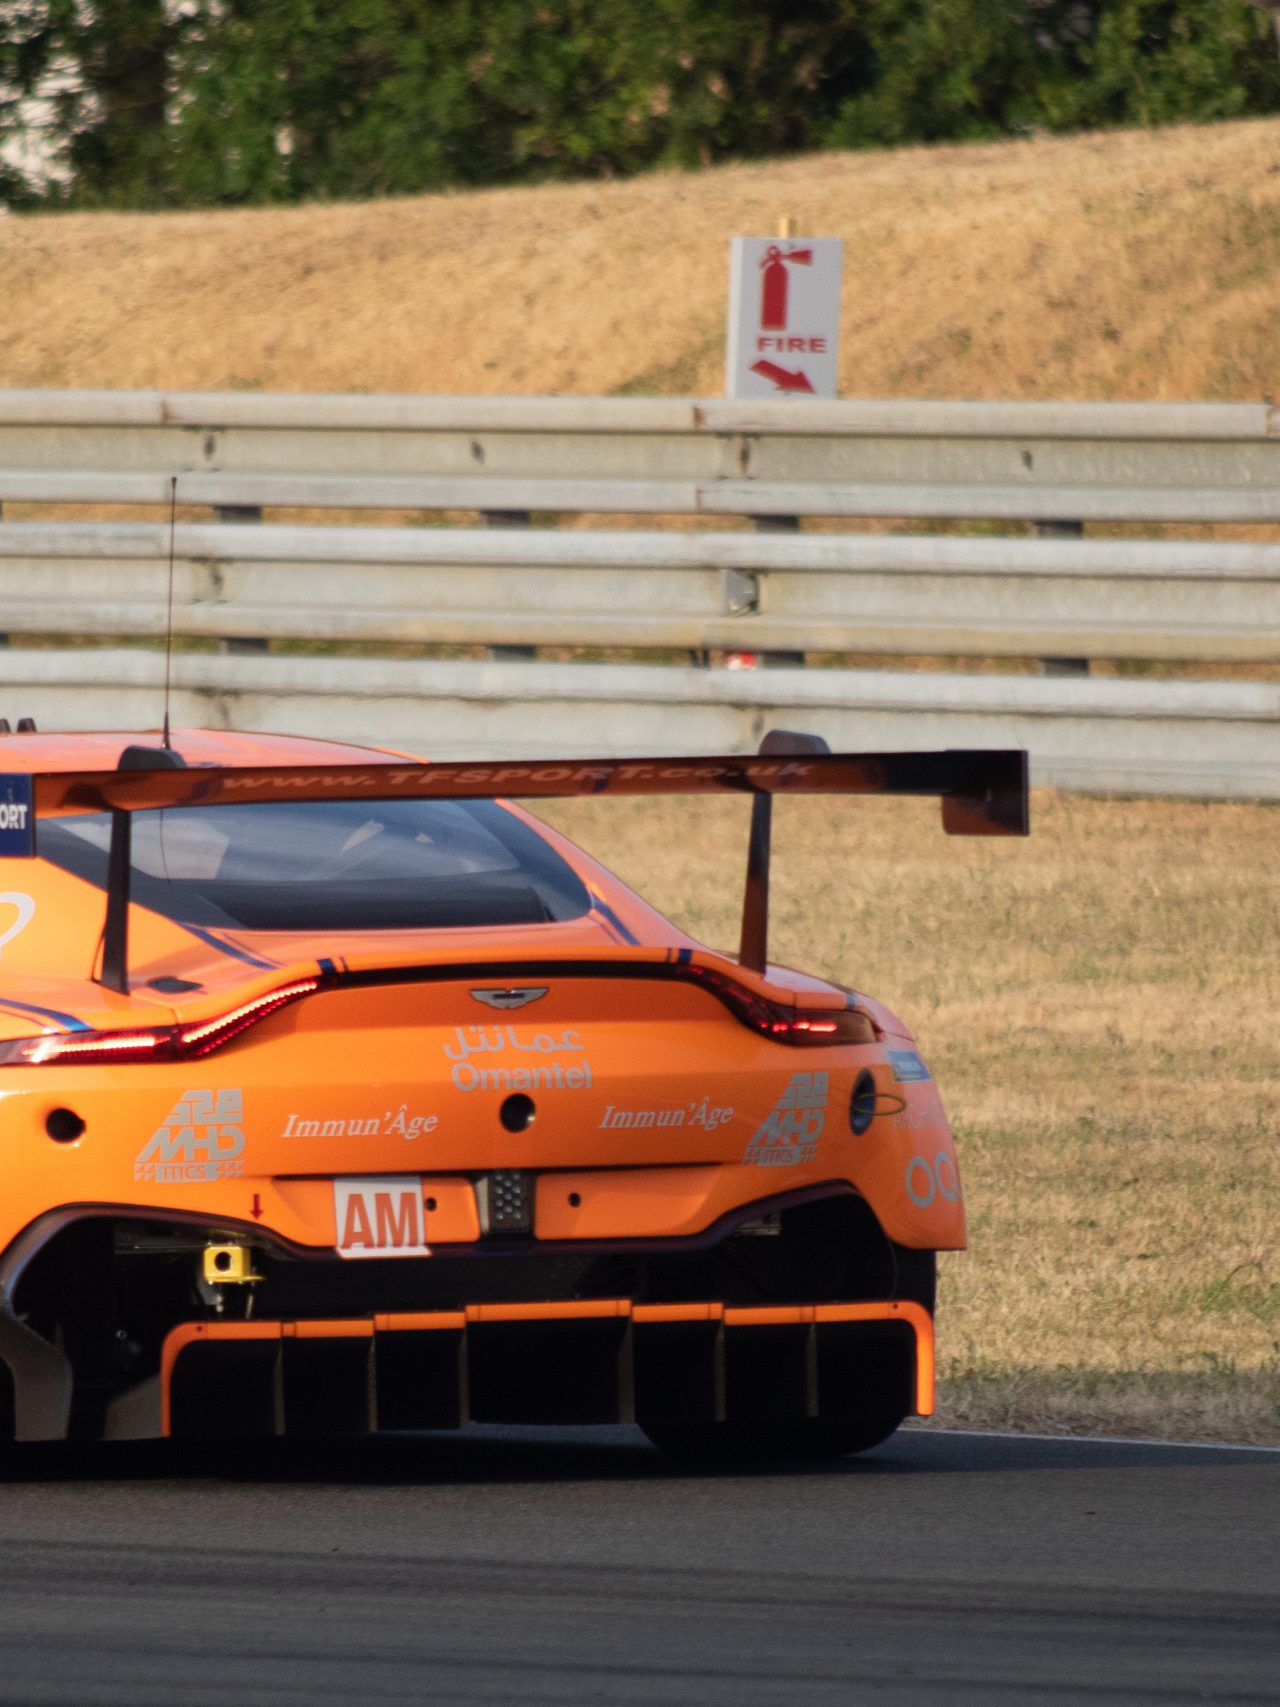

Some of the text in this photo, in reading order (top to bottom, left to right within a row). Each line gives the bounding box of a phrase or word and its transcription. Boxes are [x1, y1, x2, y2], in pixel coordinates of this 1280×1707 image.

[757, 338, 827, 353] FIRE
[451, 1059, 592, 1092] Omantel
[136, 1125, 245, 1161] MHD
[747, 1108, 825, 1147] MHD
[340, 1192, 420, 1250] AM
